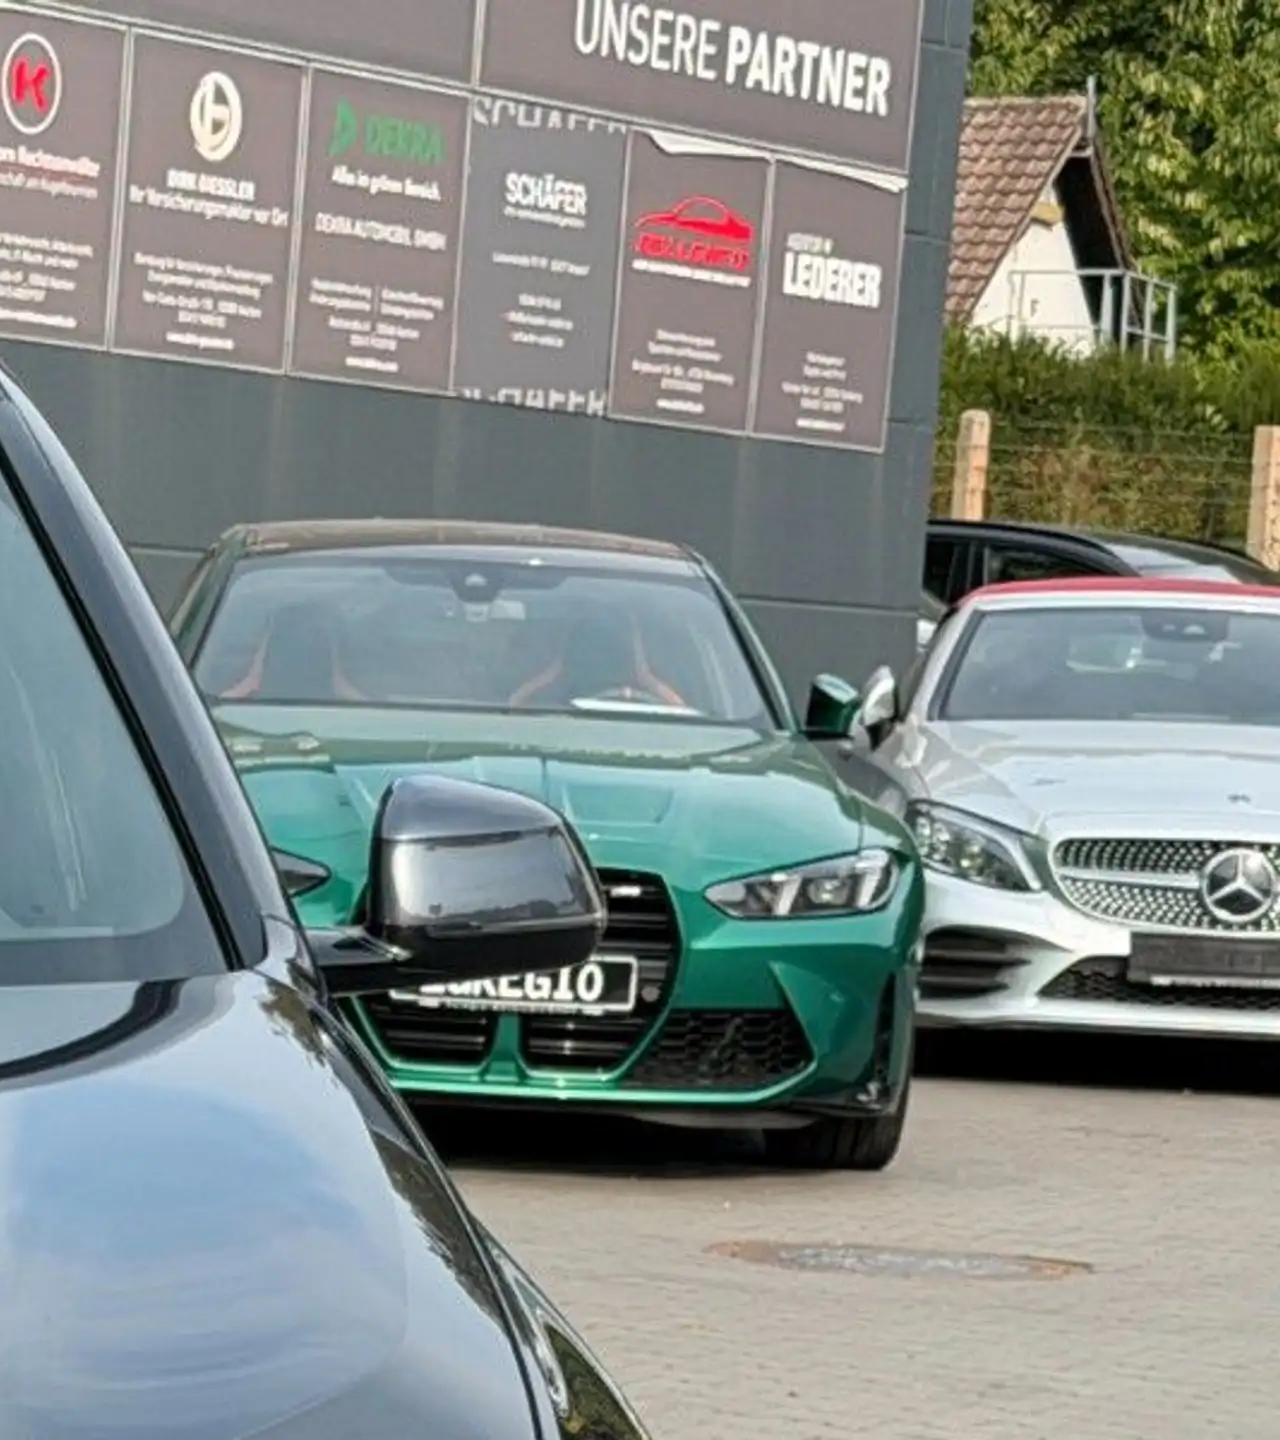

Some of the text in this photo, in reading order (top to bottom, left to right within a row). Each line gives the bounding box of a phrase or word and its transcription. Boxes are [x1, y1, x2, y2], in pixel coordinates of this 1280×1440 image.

[11, 56, 51, 114] K
[574, 0, 721, 80] UNSERE
[725, 26, 892, 117] PARTNER
[504, 171, 588, 217] SCHÄFER
[782, 251, 883, 309] LEDERER
